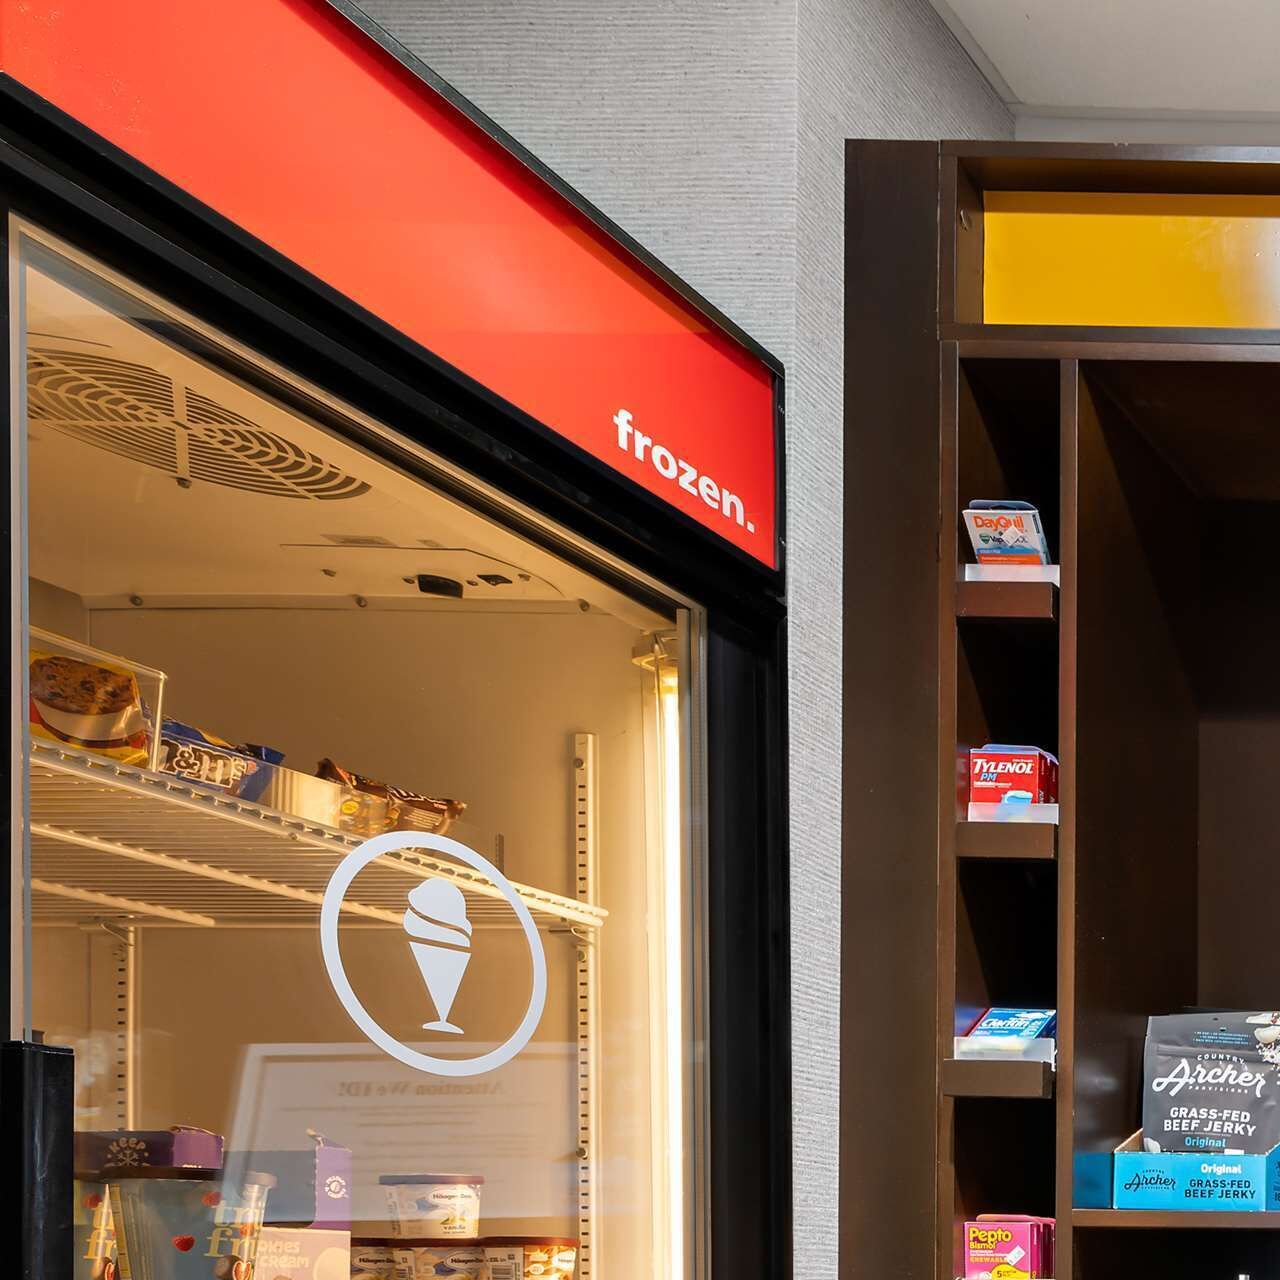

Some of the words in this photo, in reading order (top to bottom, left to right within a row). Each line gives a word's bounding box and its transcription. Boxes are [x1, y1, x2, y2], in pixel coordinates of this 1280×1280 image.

[613, 408, 755, 533] frozen.
[973, 514, 1024, 533] DayQuil
[973, 758, 1034, 775] TYLENOL
[979, 772, 998, 782] PM
[981, 1018, 1030, 1030] Claritin
[1152, 1058, 1267, 1098] Archer
[1170, 1107, 1251, 1122] GRASS-FED
[1163, 1119, 1200, 1132] BEEF
[1203, 1121, 1257, 1137] JERKY
[1184, 1137, 1226, 1149] Original
[1200, 1163, 1243, 1175] Original
[1124, 1173, 1177, 1192] Archer
[1189, 1179, 1251, 1189] GRASS-FED
[1184, 1189, 1214, 1199] BEEF
[1217, 1189, 1256, 1199] JERKY
[969, 1227, 1012, 1246] Pepto
[969, 1240, 997, 1250] Bismol
